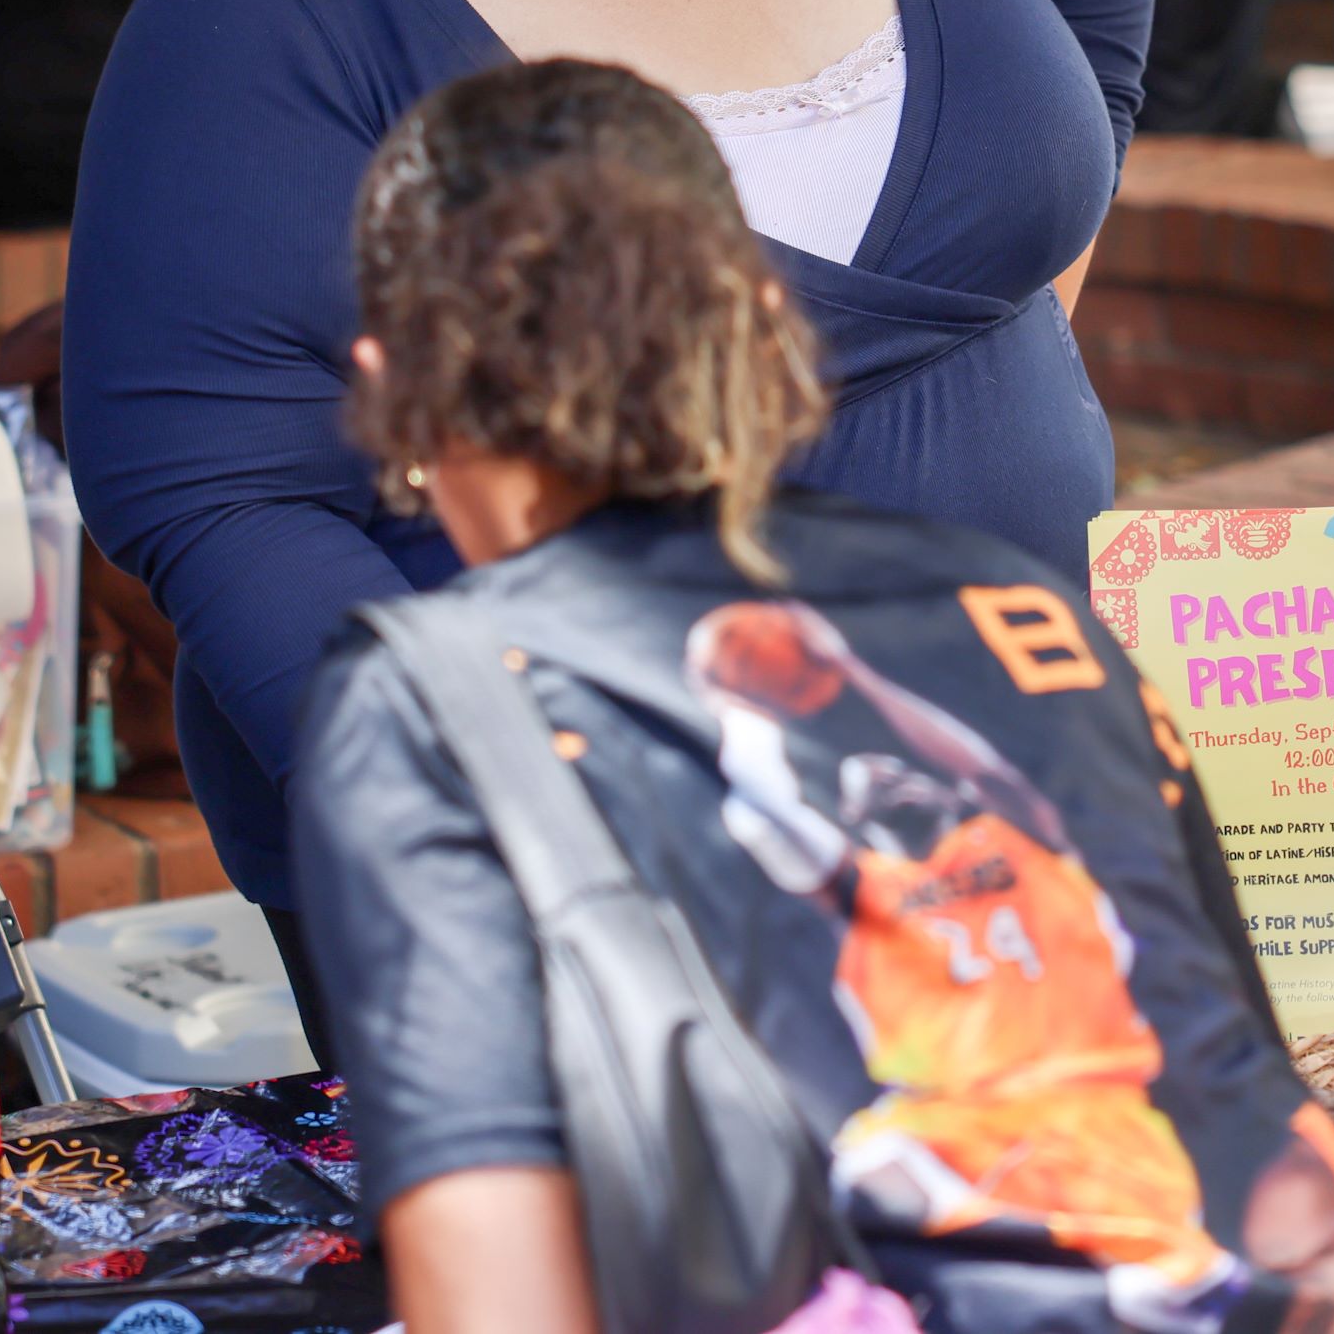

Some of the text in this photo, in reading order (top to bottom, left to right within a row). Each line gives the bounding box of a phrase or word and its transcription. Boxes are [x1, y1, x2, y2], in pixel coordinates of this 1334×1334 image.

[1189, 727, 1289, 749] Thursday,
[1271, 780, 1291, 797] In
[1297, 777, 1327, 795] the
[1216, 824, 1255, 836] ARADE
[1260, 823, 1283, 835] AND
[1288, 822, 1325, 834] PARTY
[1249, 850, 1263, 860] OF
[1266, 915, 1296, 930] FOR
[1252, 939, 1293, 957] HILE
[1269, 980, 1297, 990] atine
[1286, 993, 1303, 1003] the
